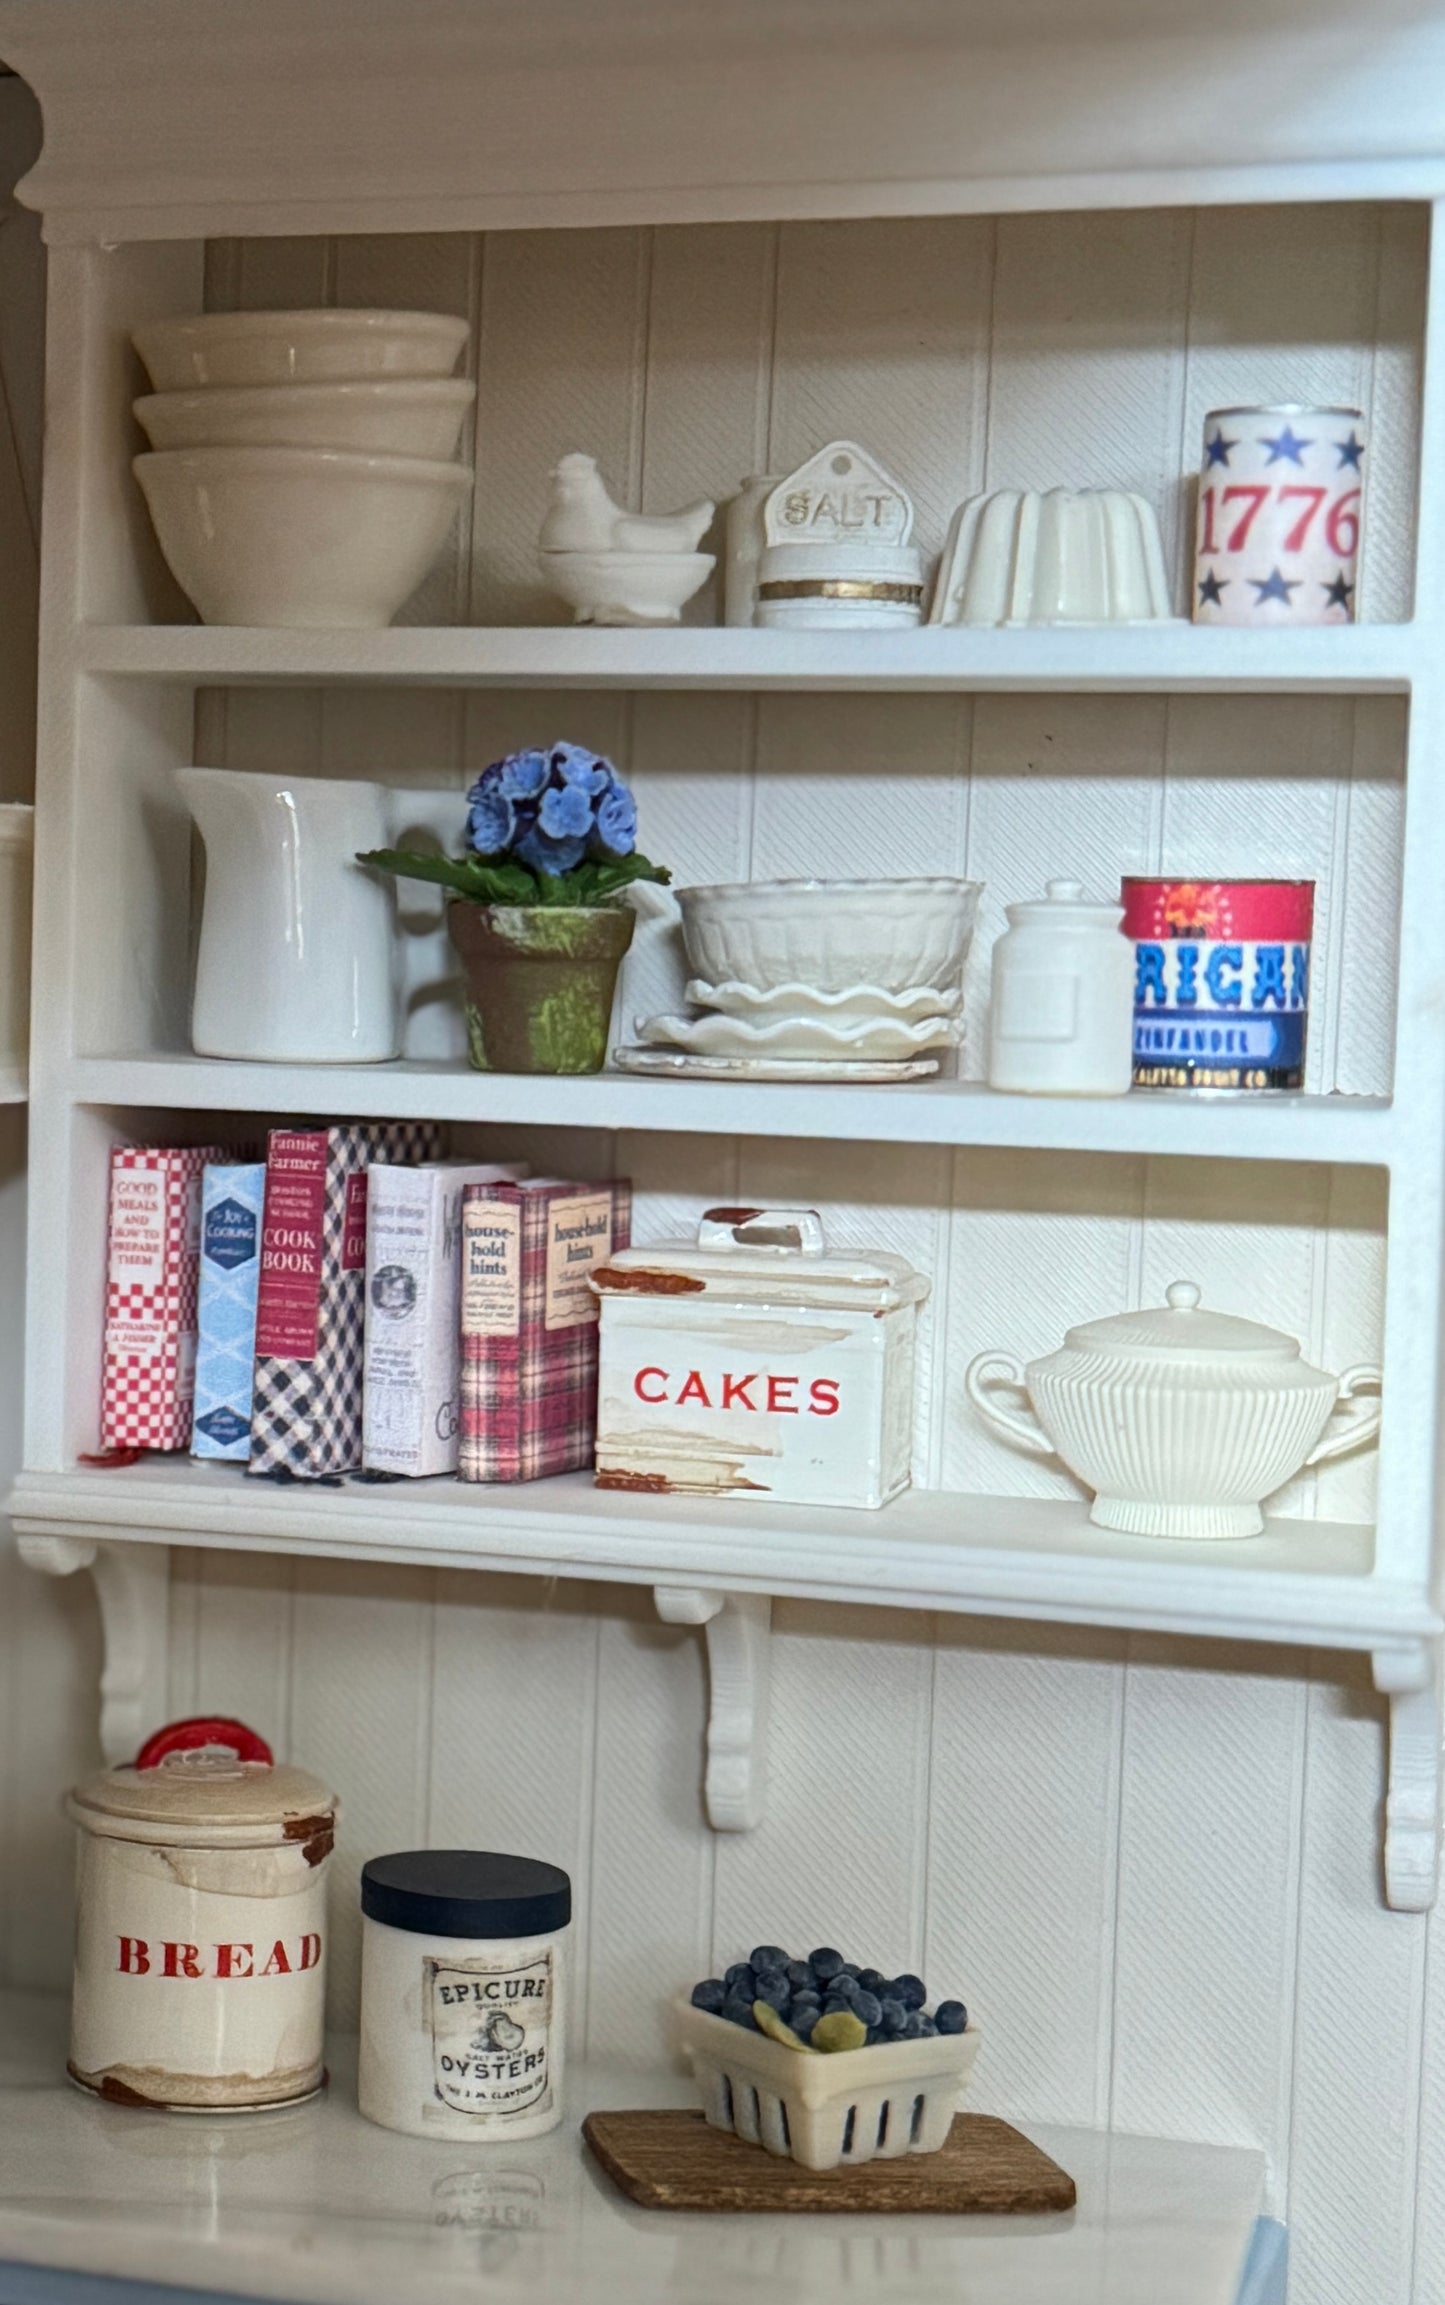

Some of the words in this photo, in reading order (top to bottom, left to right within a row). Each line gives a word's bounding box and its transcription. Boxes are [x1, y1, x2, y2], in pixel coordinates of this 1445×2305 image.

[784, 489, 892, 527] SALT
[1199, 485, 1361, 558] 1776
[270, 1131, 319, 1152] Fannie
[268, 1153, 319, 1171] Farmer
[117, 1181, 158, 1195] GOOD
[118, 1200, 159, 1212] MEALS
[123, 1214, 149, 1226] AND
[263, 1228, 316, 1250] COOK
[470, 1240, 506, 1257] hold
[262, 1251, 315, 1273] BOOK
[469, 1258, 508, 1275] hints
[633, 1366, 841, 1416] CAKES
[117, 1932, 321, 1979] BREAD
[440, 1979, 546, 2005] EPICURE
[441, 2046, 545, 2079] OYSTERS
